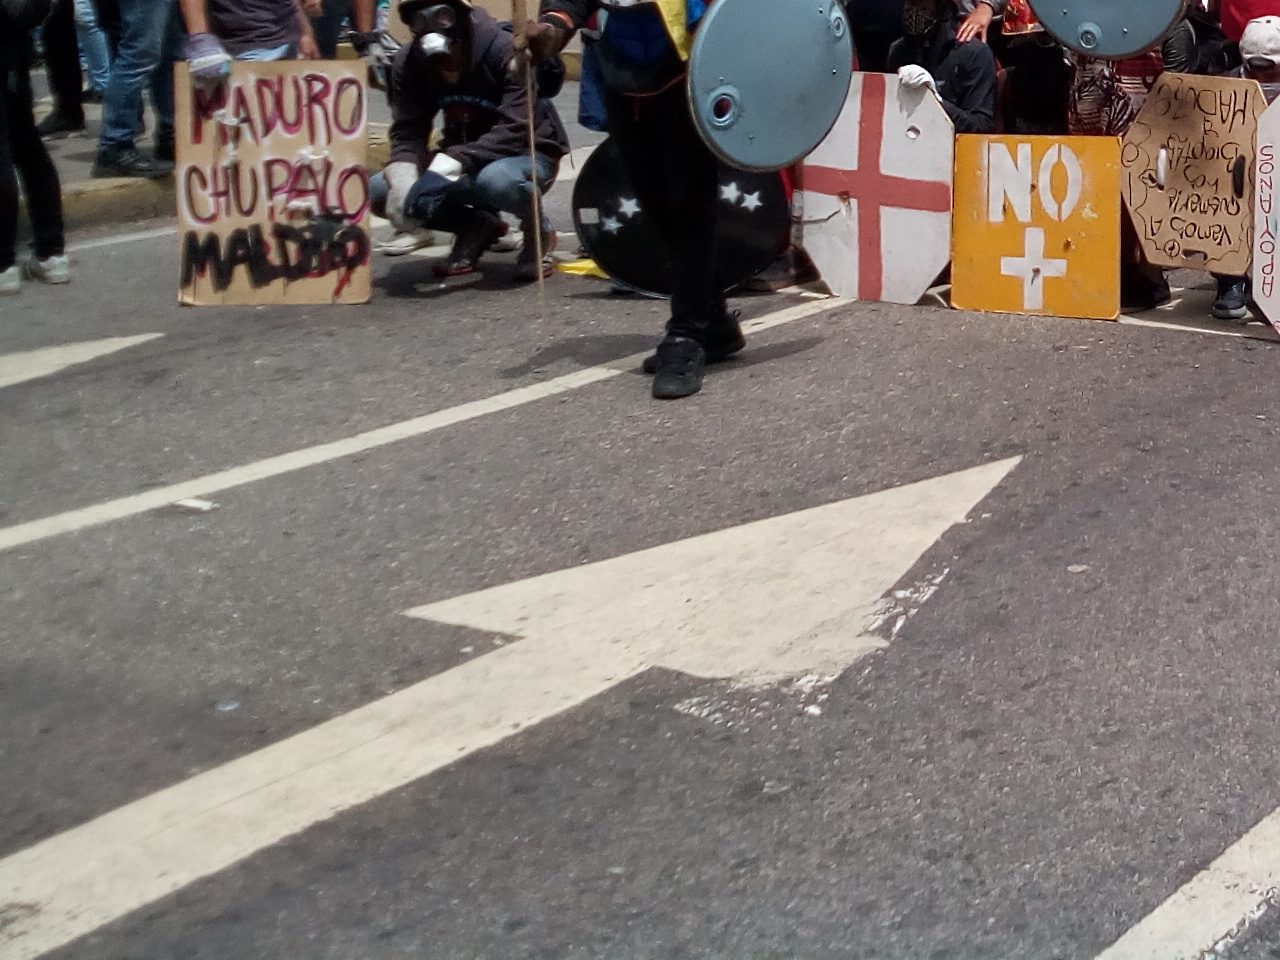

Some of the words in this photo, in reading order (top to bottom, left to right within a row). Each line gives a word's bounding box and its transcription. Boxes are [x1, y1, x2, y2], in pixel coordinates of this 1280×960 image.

[191, 72, 364, 146] MADURO
[184, 156, 370, 224] CHUPALO
[988, 142, 1083, 223] NO
[1259, 145, 1276, 298] APOYANOS
